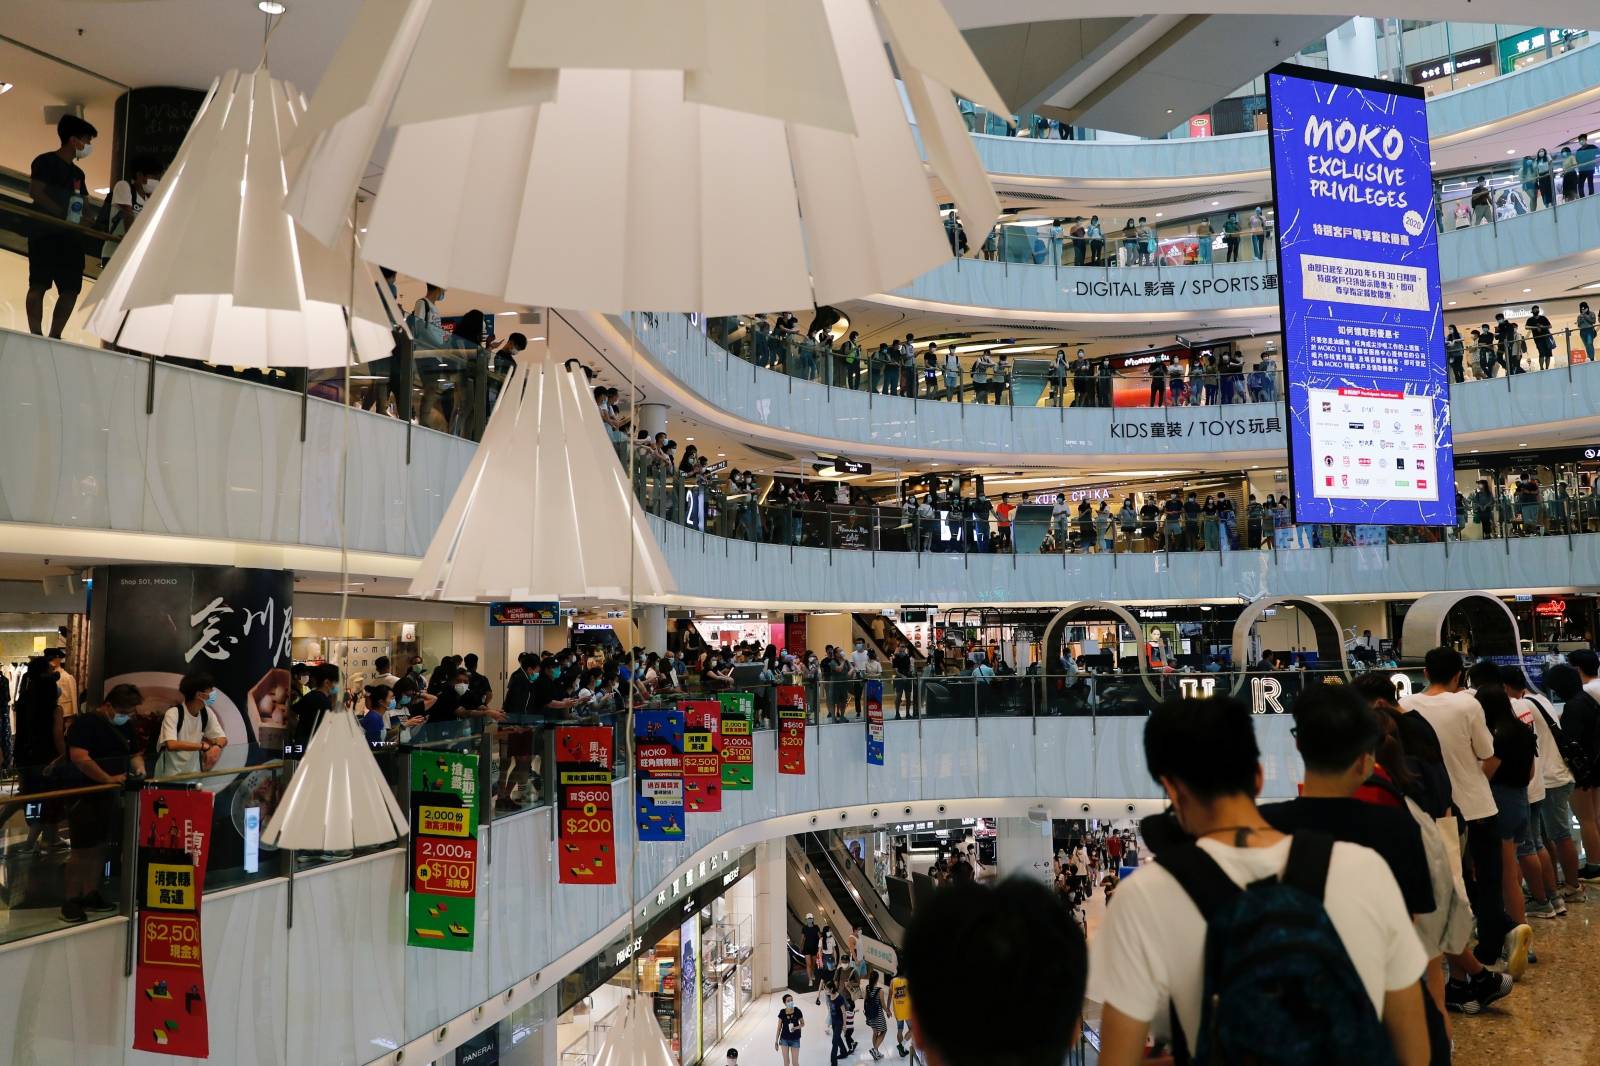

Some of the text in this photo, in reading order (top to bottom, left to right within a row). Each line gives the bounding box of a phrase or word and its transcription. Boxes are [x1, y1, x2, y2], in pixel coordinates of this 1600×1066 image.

[1305, 114, 1404, 160] MOKO
[1308, 155, 1406, 186] EXCLUSIVE
[1310, 179, 1408, 208] PRIVILEGES
[1405, 216, 1422, 230] 2020
[1345, 267, 1363, 277] 2020
[1387, 272, 1395, 280] 30
[1076, 281, 1141, 297] DIGITAL
[1144, 281, 1175, 297] 影音
[1193, 276, 1259, 295] SPORTS
[1111, 423, 1148, 438] KIDS
[1150, 421, 1182, 437] 童裝
[1199, 420, 1245, 436] TOYS
[1249, 418, 1281, 434] 玩具
[640, 748, 667, 758] MOKO
[729, 748, 751, 756] $100
[684, 758, 717, 766] $2,500
[425, 810, 463, 822] 2,000 份
[567, 818, 611, 835] $200
[432, 862, 470, 880] $100
[462, 1044, 494, 1065] PANERAI
